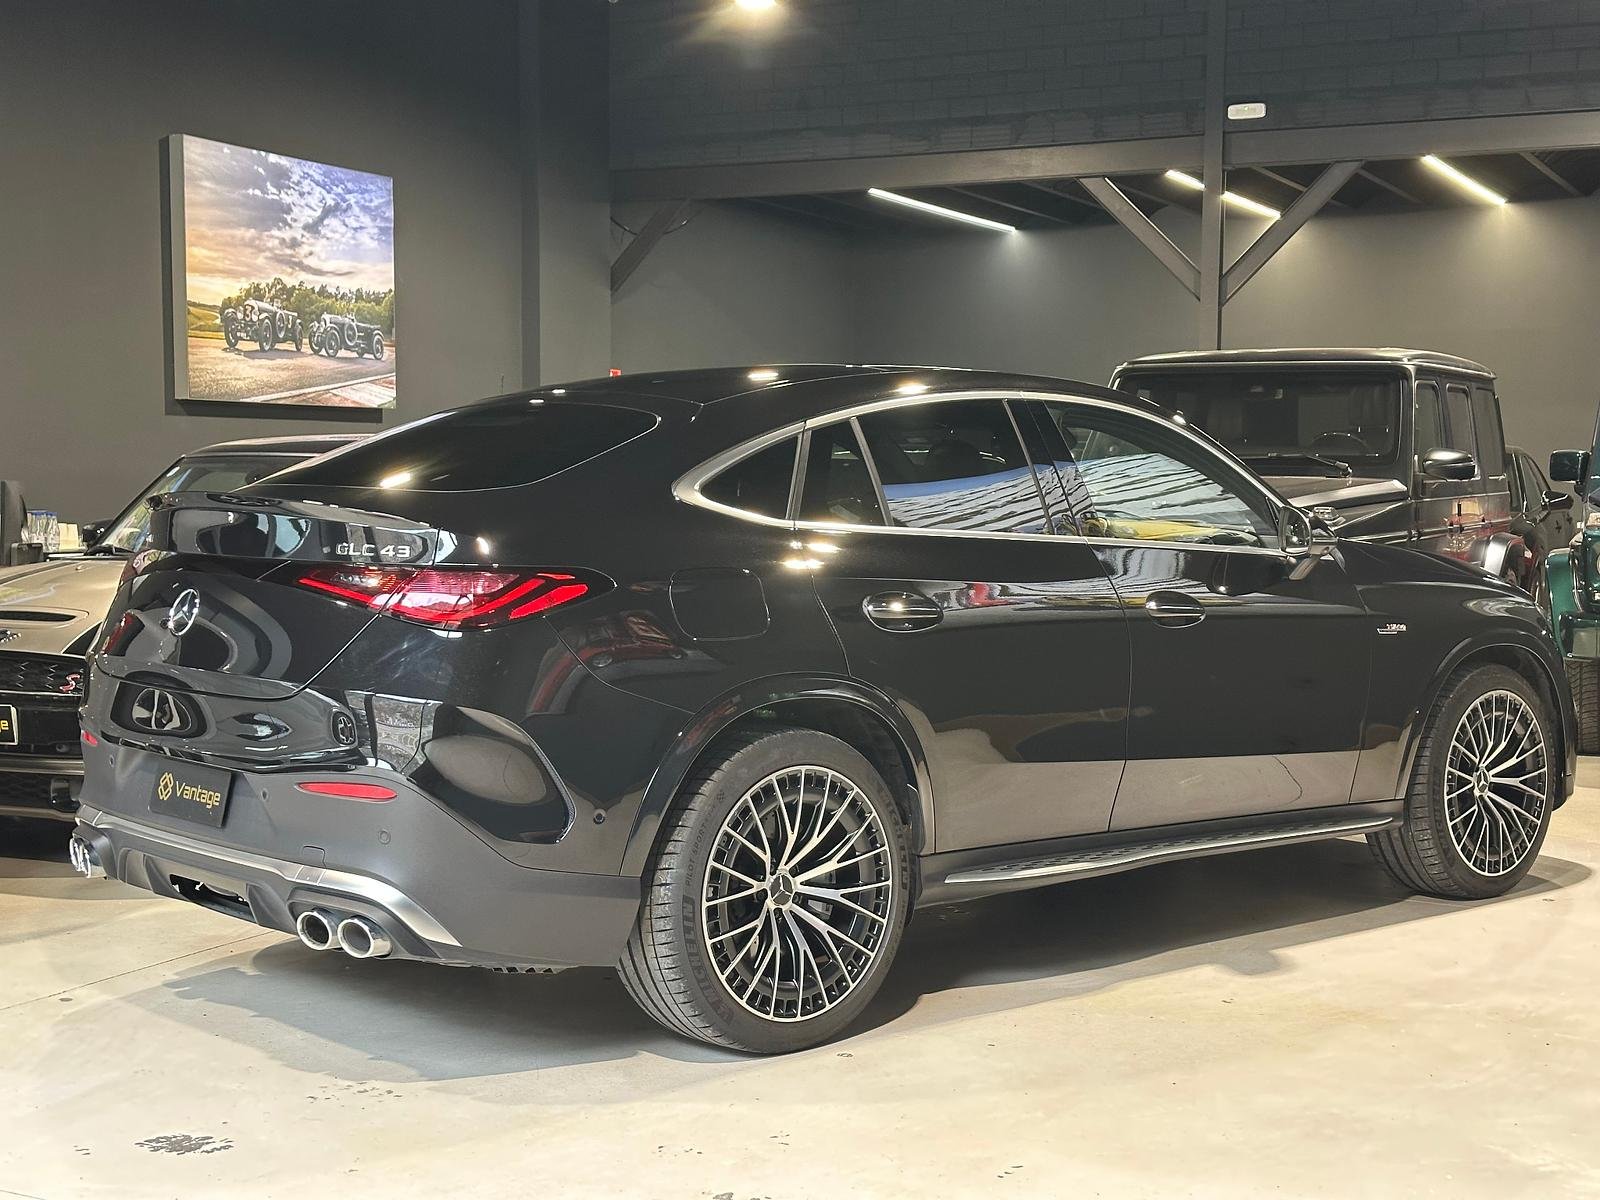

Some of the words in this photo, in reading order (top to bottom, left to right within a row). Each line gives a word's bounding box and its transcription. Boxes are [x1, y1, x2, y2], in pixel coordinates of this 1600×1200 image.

[336, 542, 375, 556] GLC
[380, 545, 410, 558] 43
[175, 780, 221, 809] Vantage
